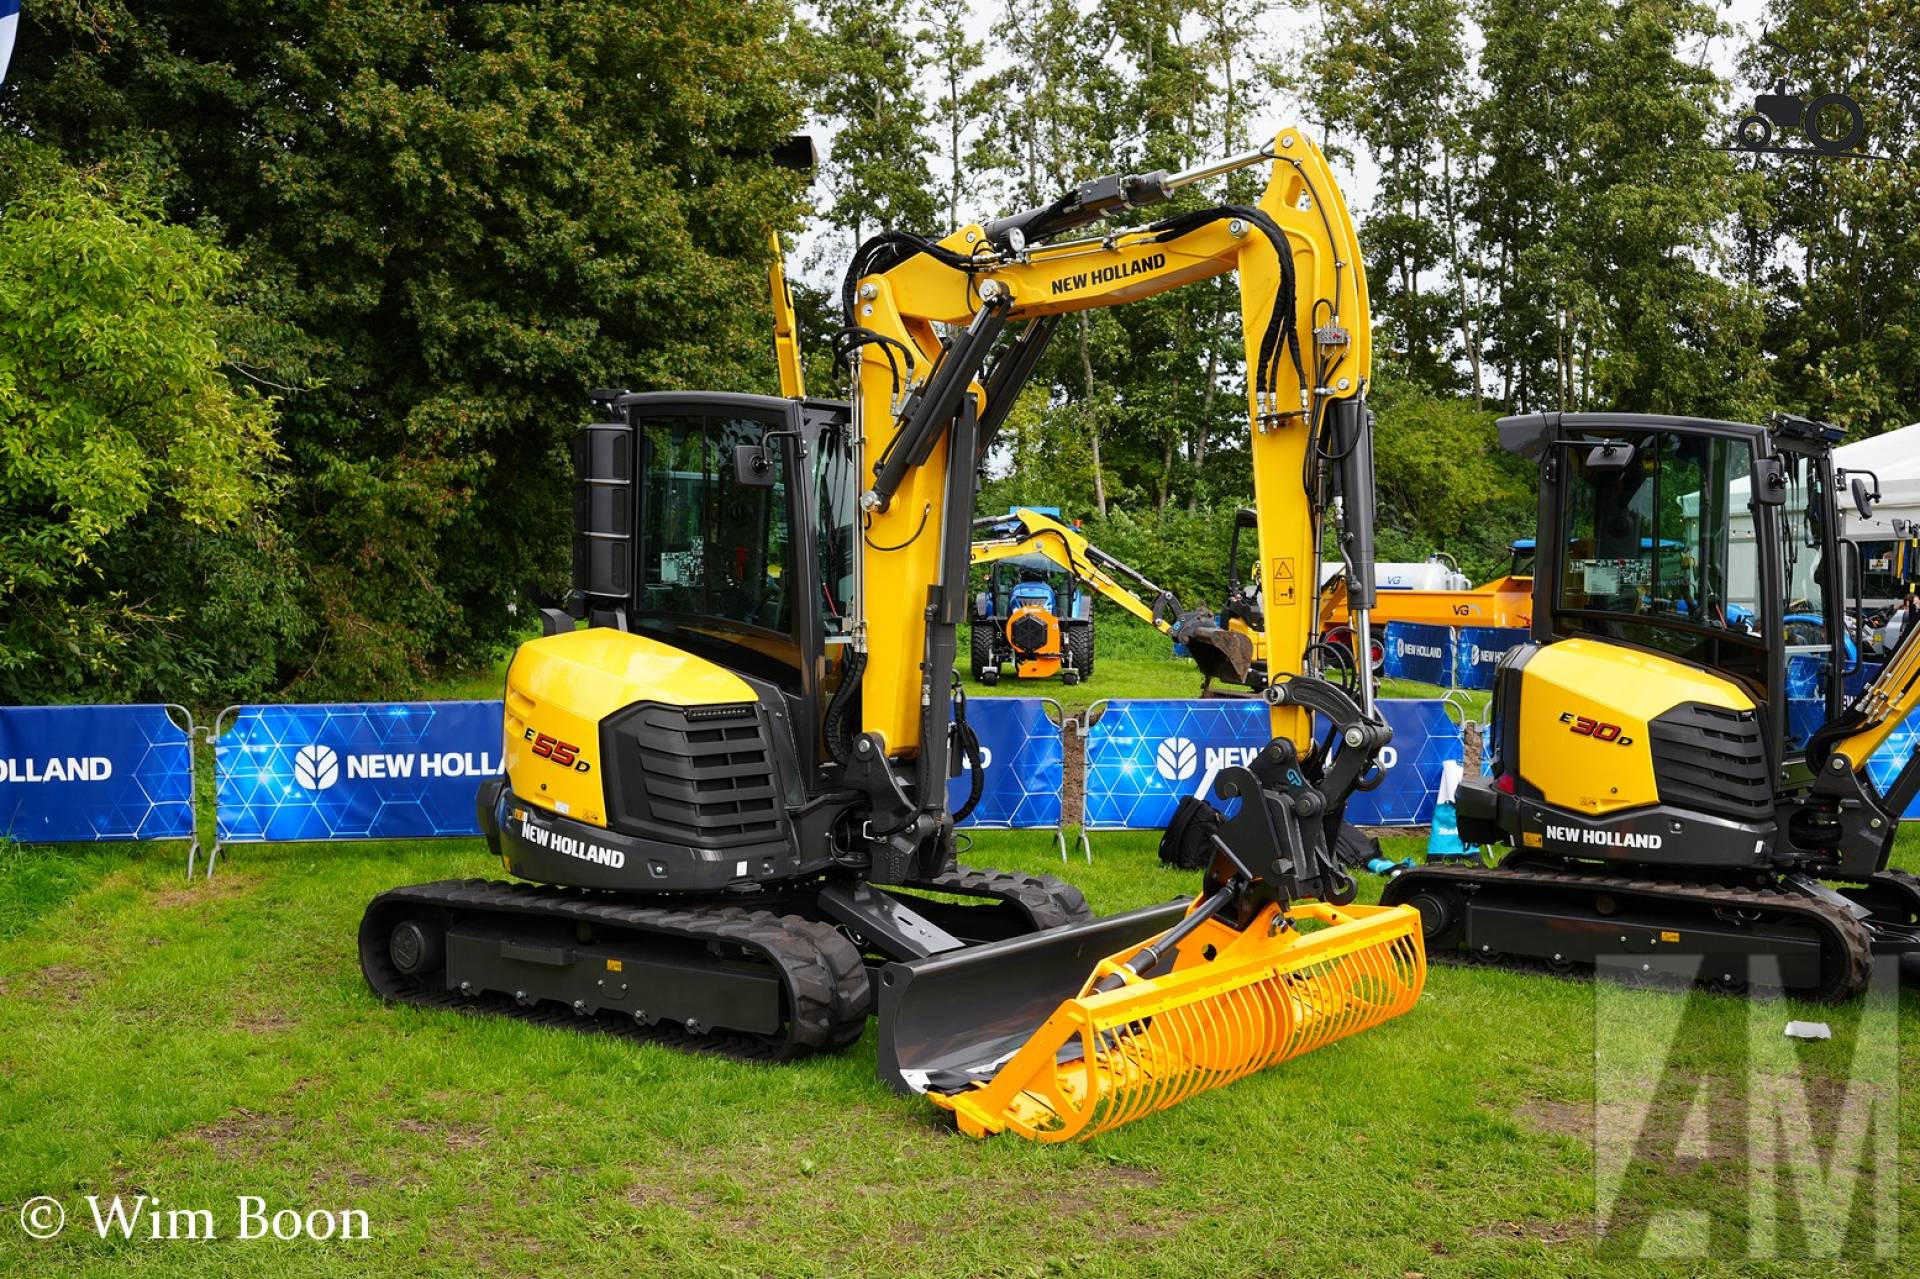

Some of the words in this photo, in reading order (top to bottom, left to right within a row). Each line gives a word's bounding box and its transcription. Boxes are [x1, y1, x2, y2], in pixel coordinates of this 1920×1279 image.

[1051, 272, 1087, 295] NEW
[1091, 253, 1166, 285] HOLLAND
[1387, 575, 1401, 585] VG
[1453, 604, 1469, 616] VG
[1404, 643, 1416, 656] NEW
[1416, 645, 1442, 659] HOLLAND
[1480, 650, 1495, 662] NEW
[347, 753, 415, 778] NEW
[521, 820, 549, 847] NEW
[550, 832, 626, 869] HOLLAND
[1546, 825, 1580, 843] NEW
[1582, 829, 1663, 849] HOLLAND
